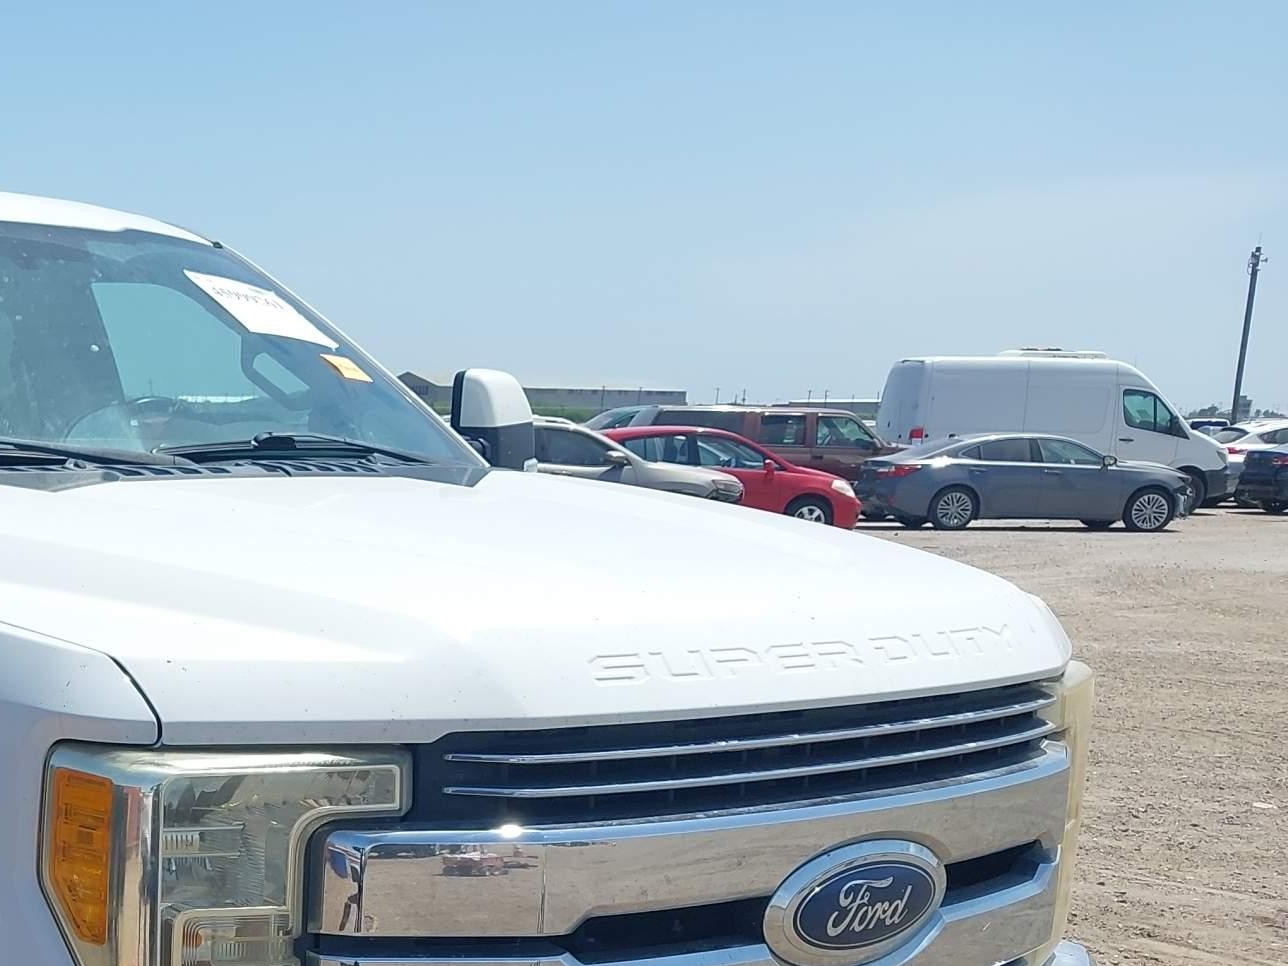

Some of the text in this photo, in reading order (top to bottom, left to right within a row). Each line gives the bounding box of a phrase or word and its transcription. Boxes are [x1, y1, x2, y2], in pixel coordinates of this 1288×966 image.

[588, 623, 1014, 687] SUPER DUTY
[826, 876, 913, 937] Ford
